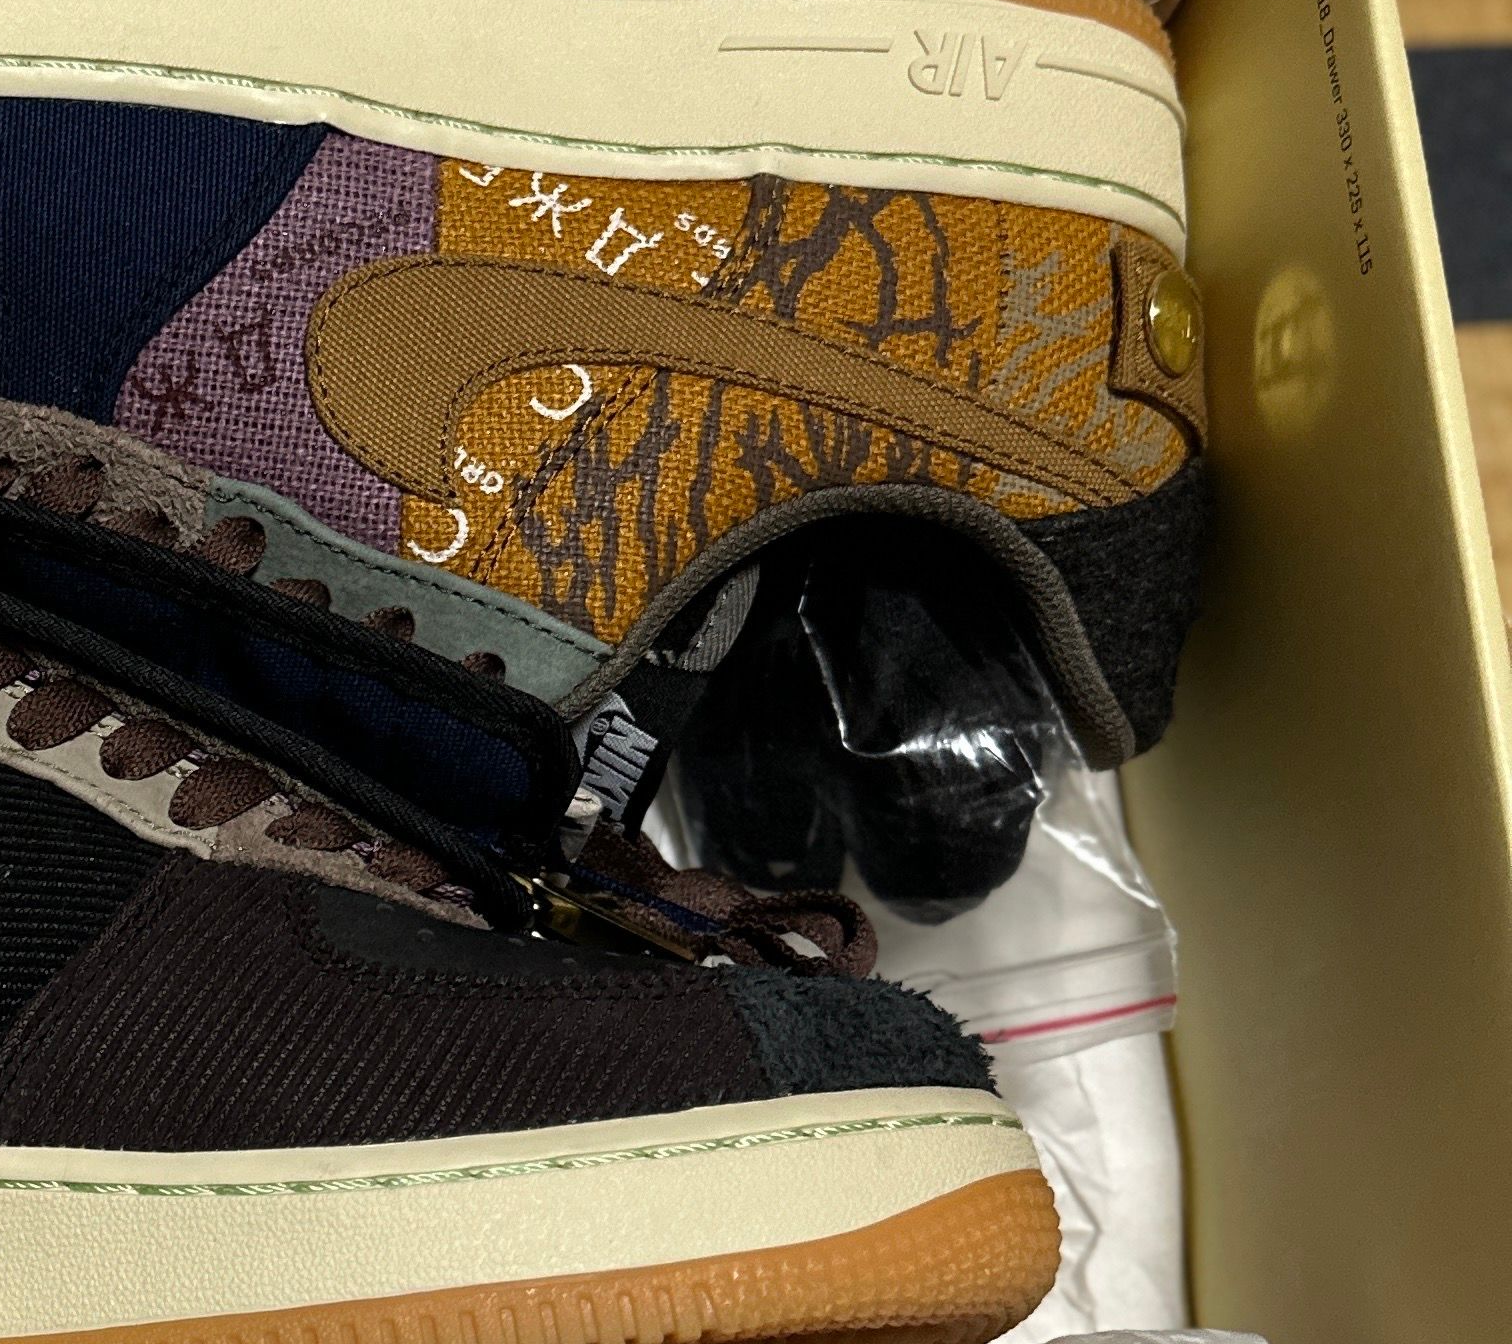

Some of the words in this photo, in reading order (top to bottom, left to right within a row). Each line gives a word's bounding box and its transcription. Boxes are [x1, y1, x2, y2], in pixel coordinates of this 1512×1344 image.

[907, 30, 1029, 101] AIR
[1334, 108, 1354, 151] 330
[1345, 173, 1364, 214] 225
[1355, 235, 1374, 276] 115
